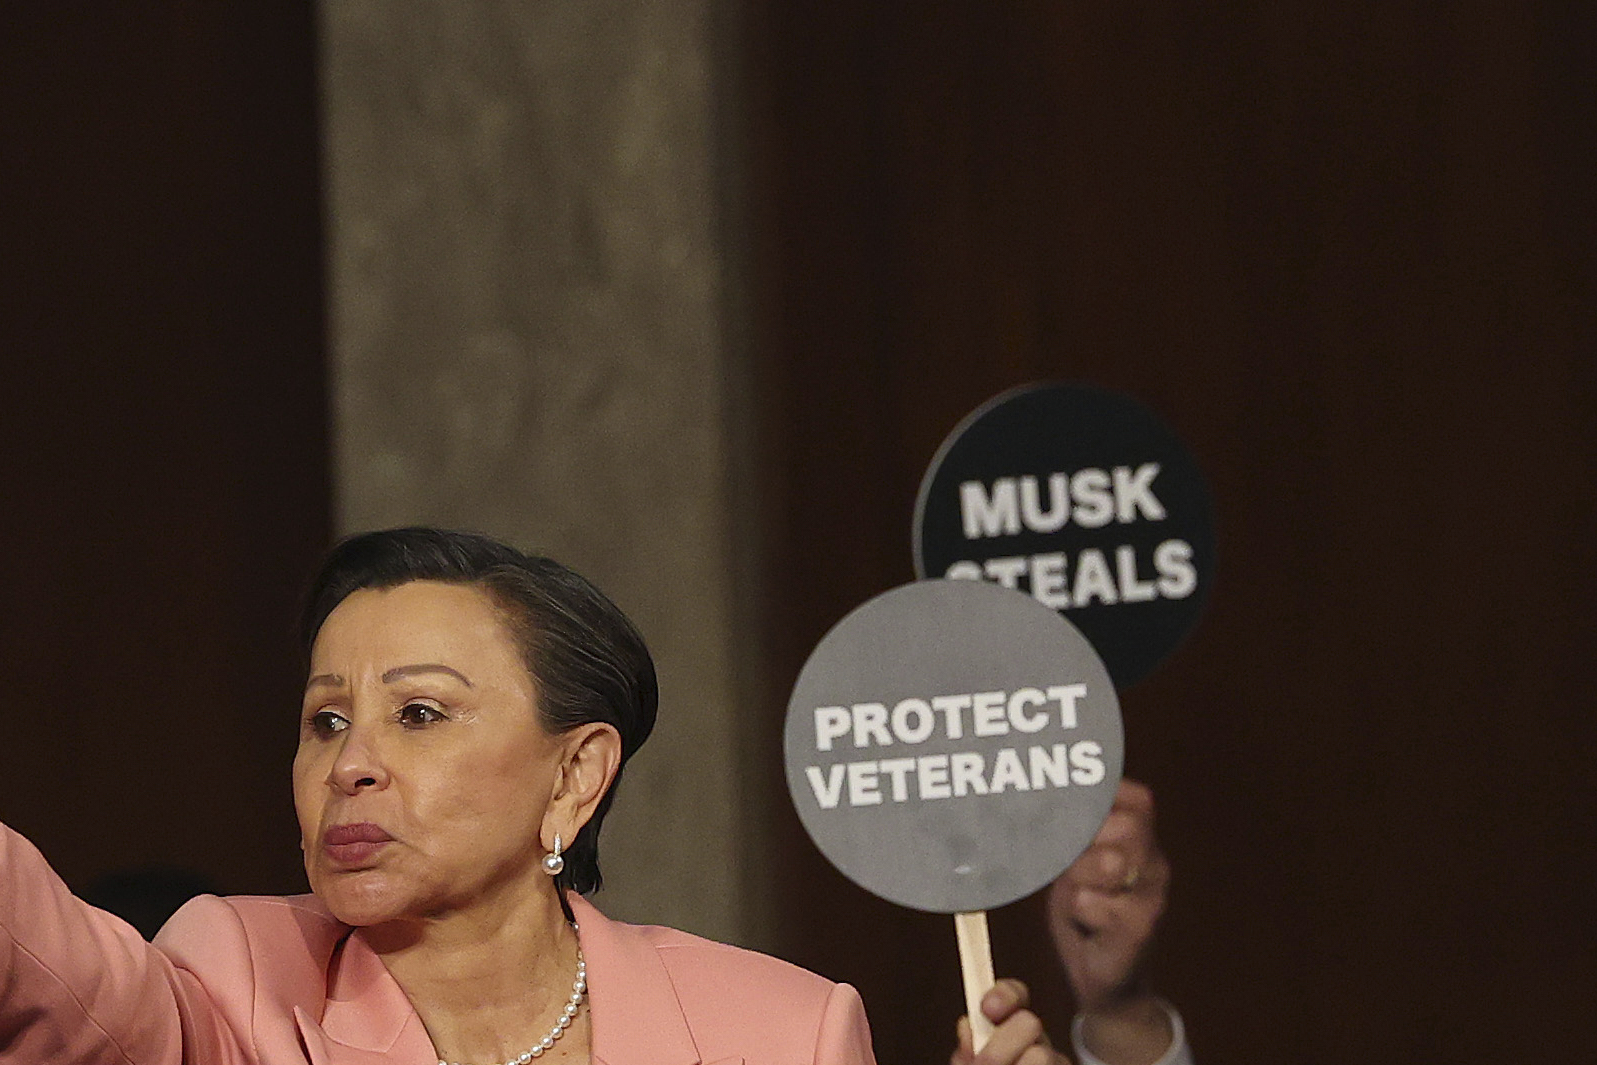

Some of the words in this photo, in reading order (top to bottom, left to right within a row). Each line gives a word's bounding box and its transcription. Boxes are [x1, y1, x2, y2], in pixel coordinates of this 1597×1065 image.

[960, 462, 1166, 540] MUSK
[813, 683, 1088, 751] PROTECT
[805, 740, 1106, 809] VETERANS
